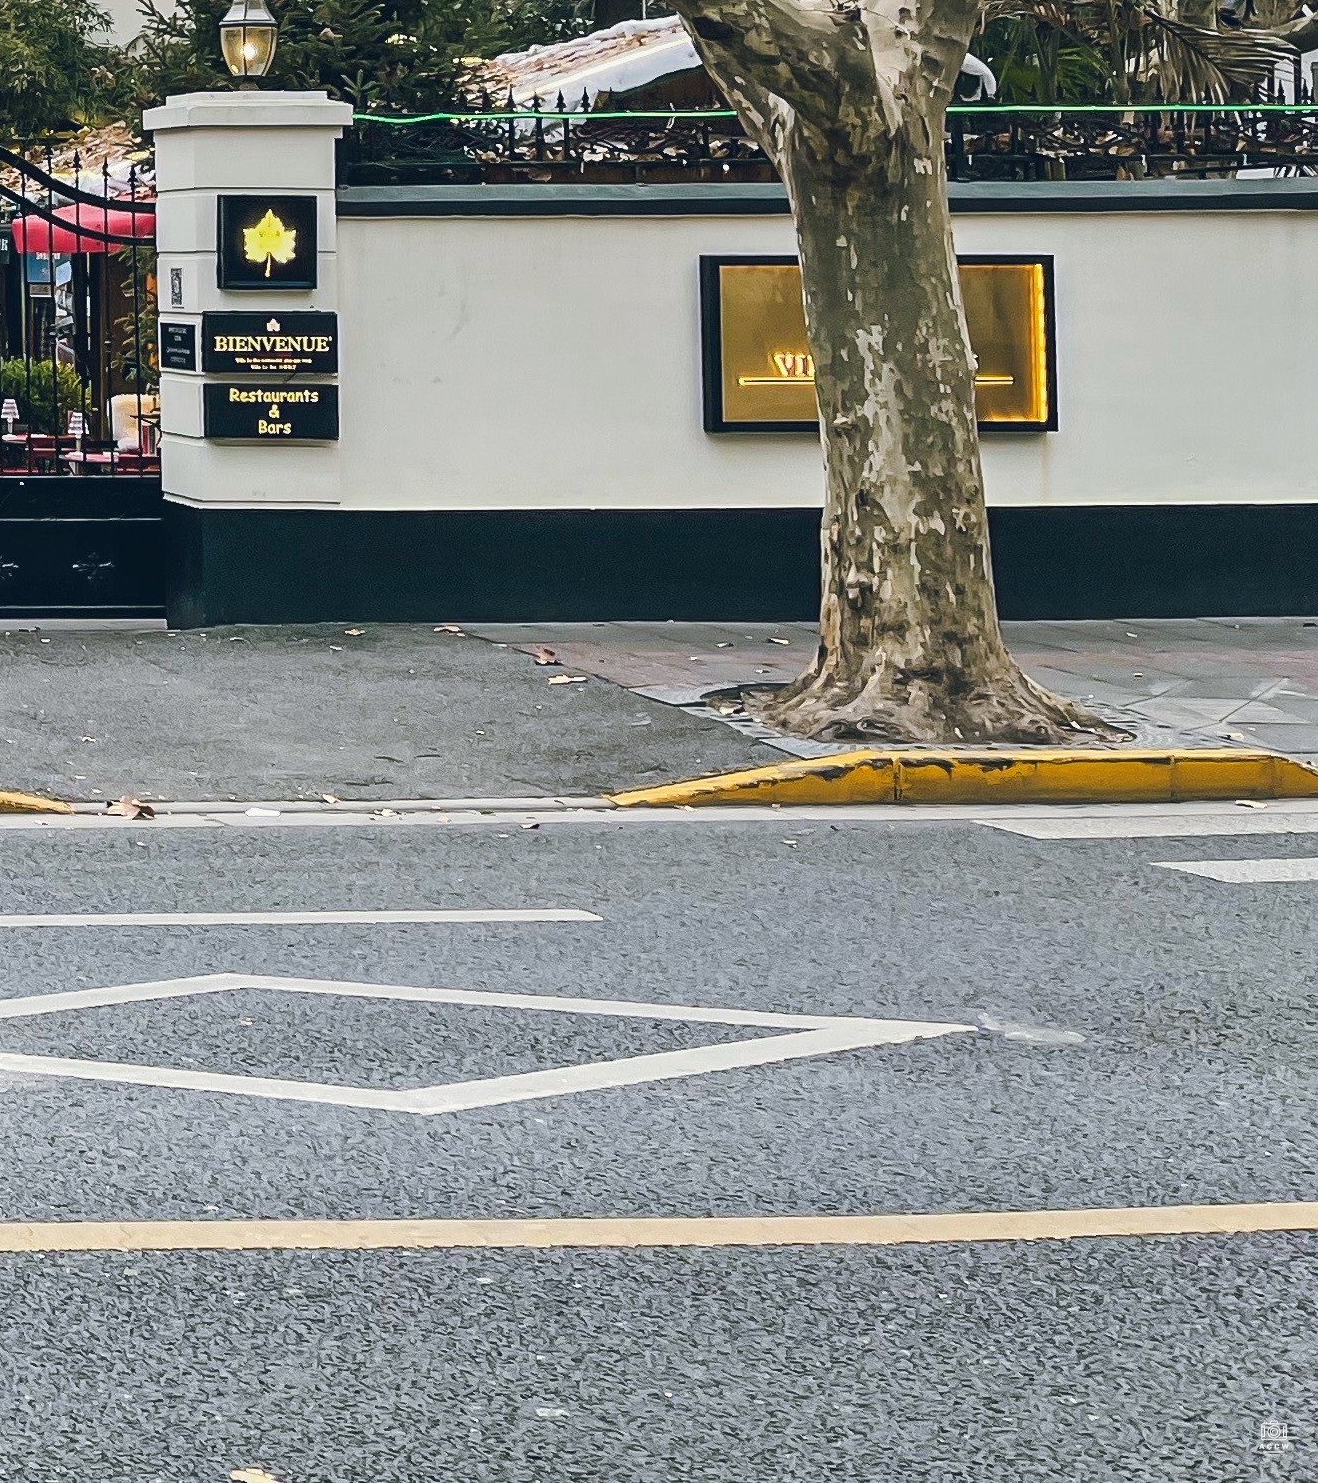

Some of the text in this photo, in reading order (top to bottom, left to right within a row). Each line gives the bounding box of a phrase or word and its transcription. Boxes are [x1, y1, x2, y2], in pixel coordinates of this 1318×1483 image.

[229, 387, 320, 403] Restaurants
[268, 404, 281, 419] &
[258, 419, 293, 436] Bars
